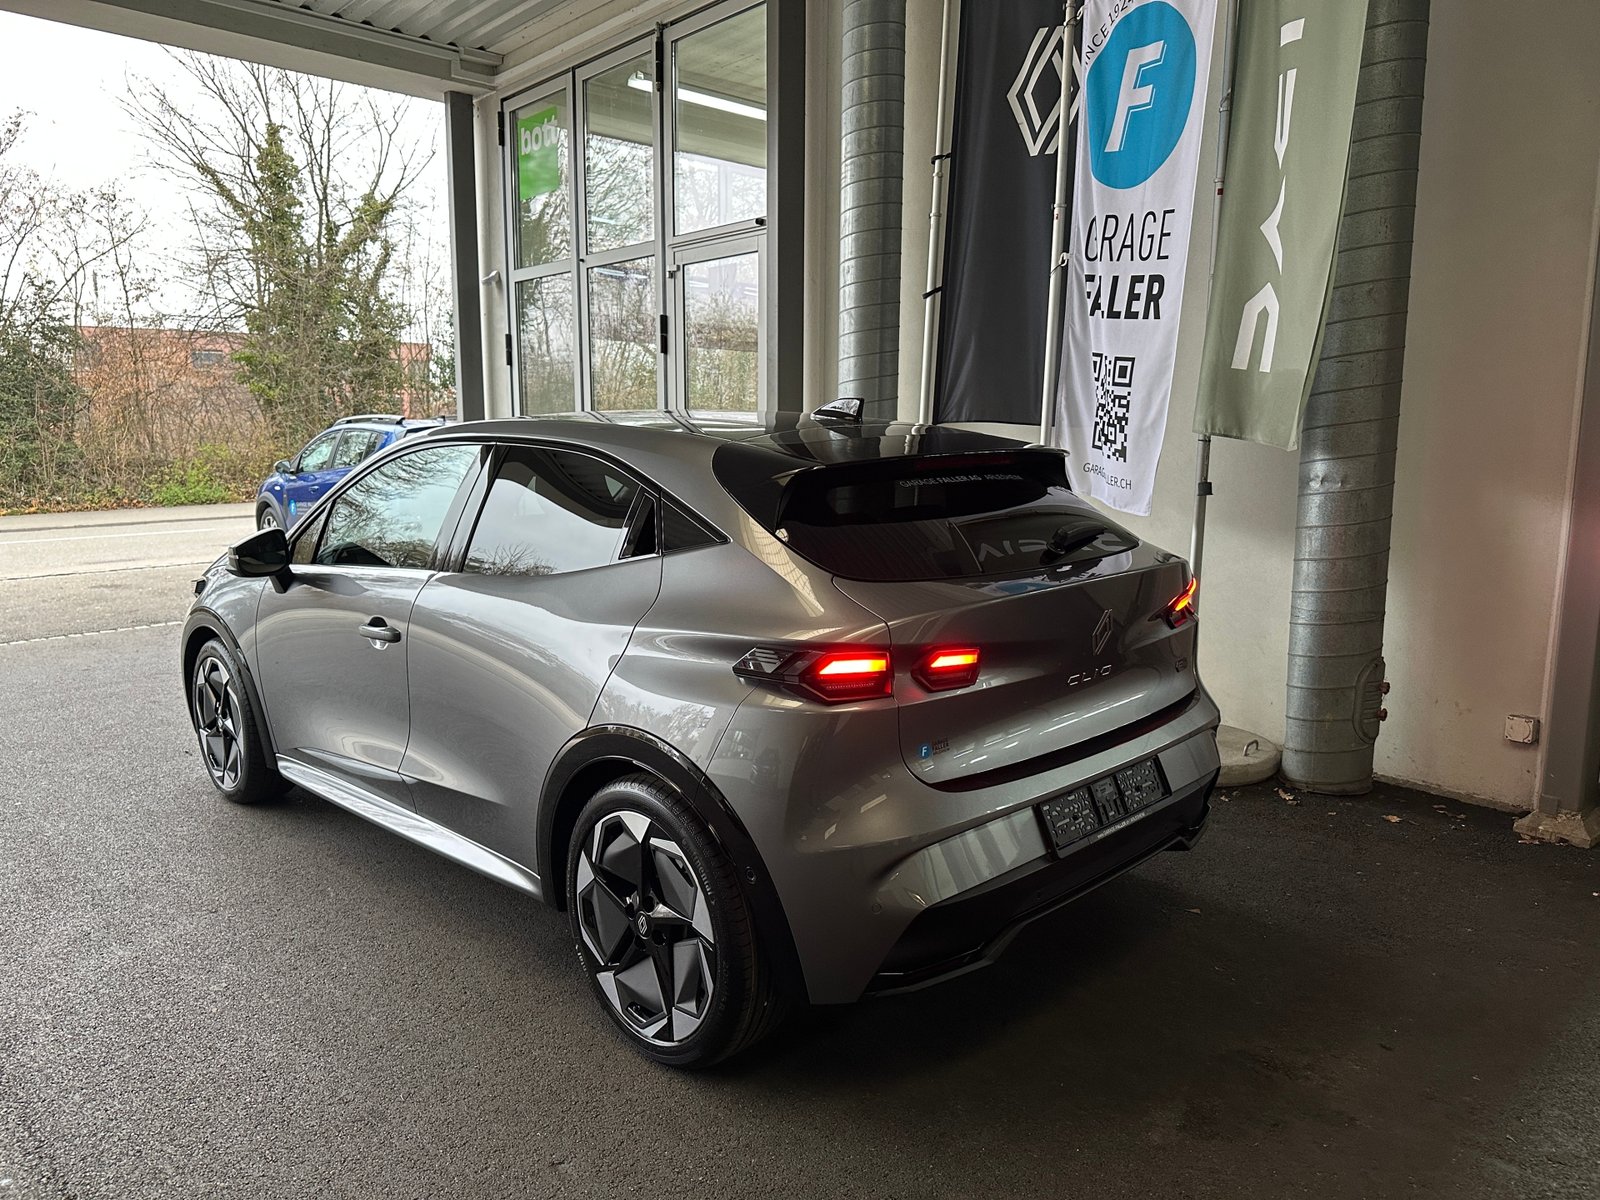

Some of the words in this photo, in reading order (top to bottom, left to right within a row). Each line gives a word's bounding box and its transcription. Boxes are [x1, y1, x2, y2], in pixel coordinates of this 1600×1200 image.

[1105, 40, 1167, 153] F
[939, 475, 969, 484] FALLER
[1067, 664, 1112, 686] CLIO
[921, 746, 928, 757] F
